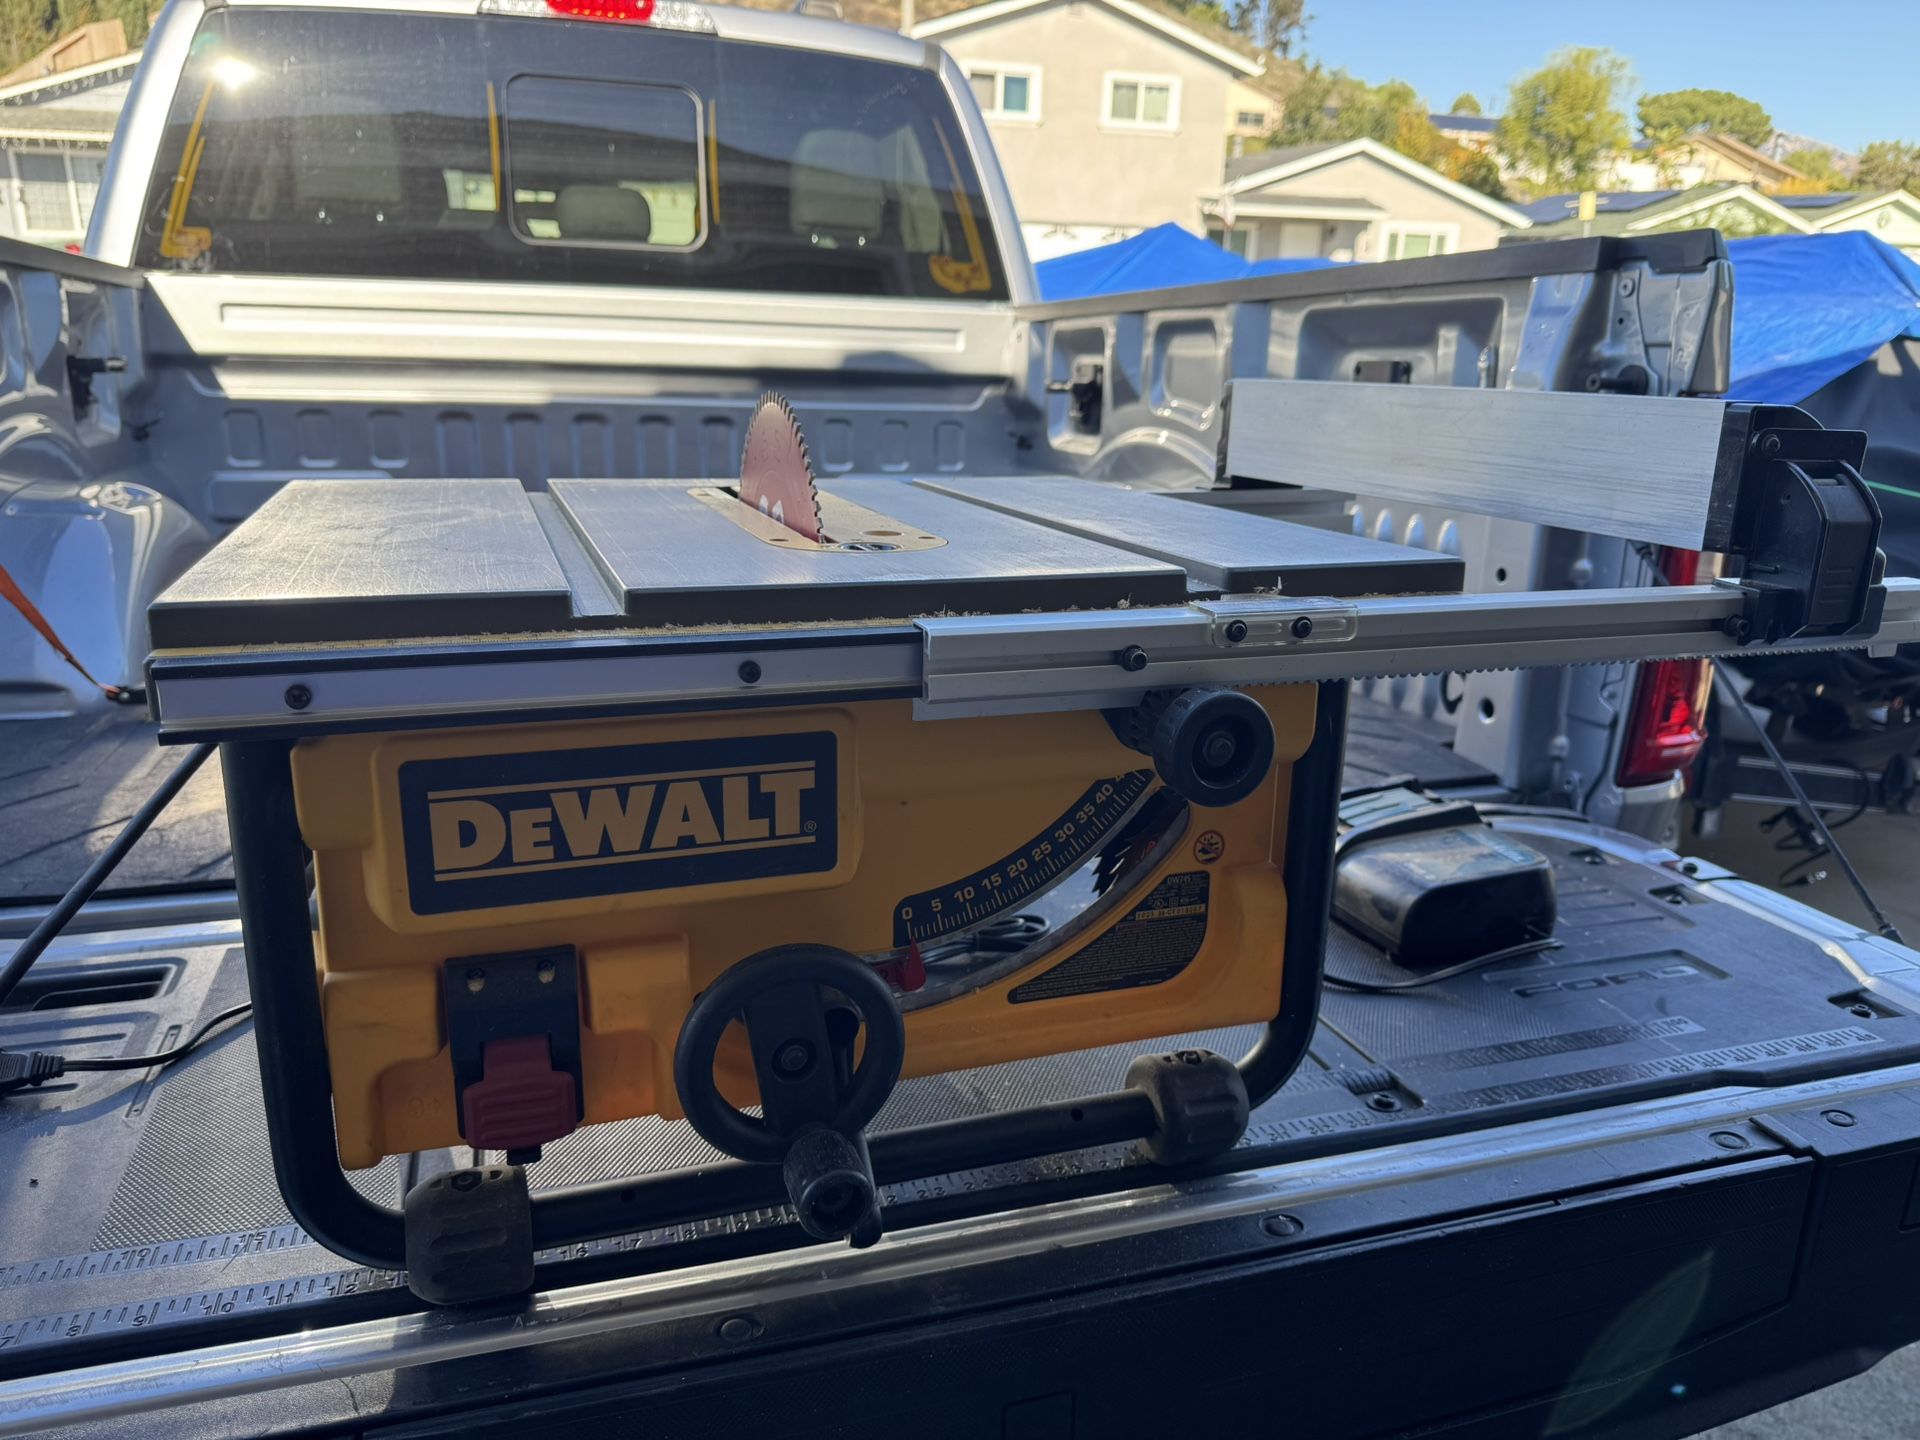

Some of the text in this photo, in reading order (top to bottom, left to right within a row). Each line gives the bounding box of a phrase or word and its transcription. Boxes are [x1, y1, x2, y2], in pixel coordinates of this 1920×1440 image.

[902, 783, 1114, 920] 0 5 10 15 20 25 30 35 40
[1511, 965, 1700, 998] FORD
[238, 1231, 267, 1243] 15
[65, 1325, 81, 1337] 8
[132, 1315, 147, 1327] 9
[204, 1302, 234, 1315] 10
[267, 1293, 293, 1305] 11
[328, 1284, 357, 1296] 12
[559, 1246, 588, 1260] 16
[615, 1238, 642, 1250] 17
[668, 1228, 697, 1242] 18
